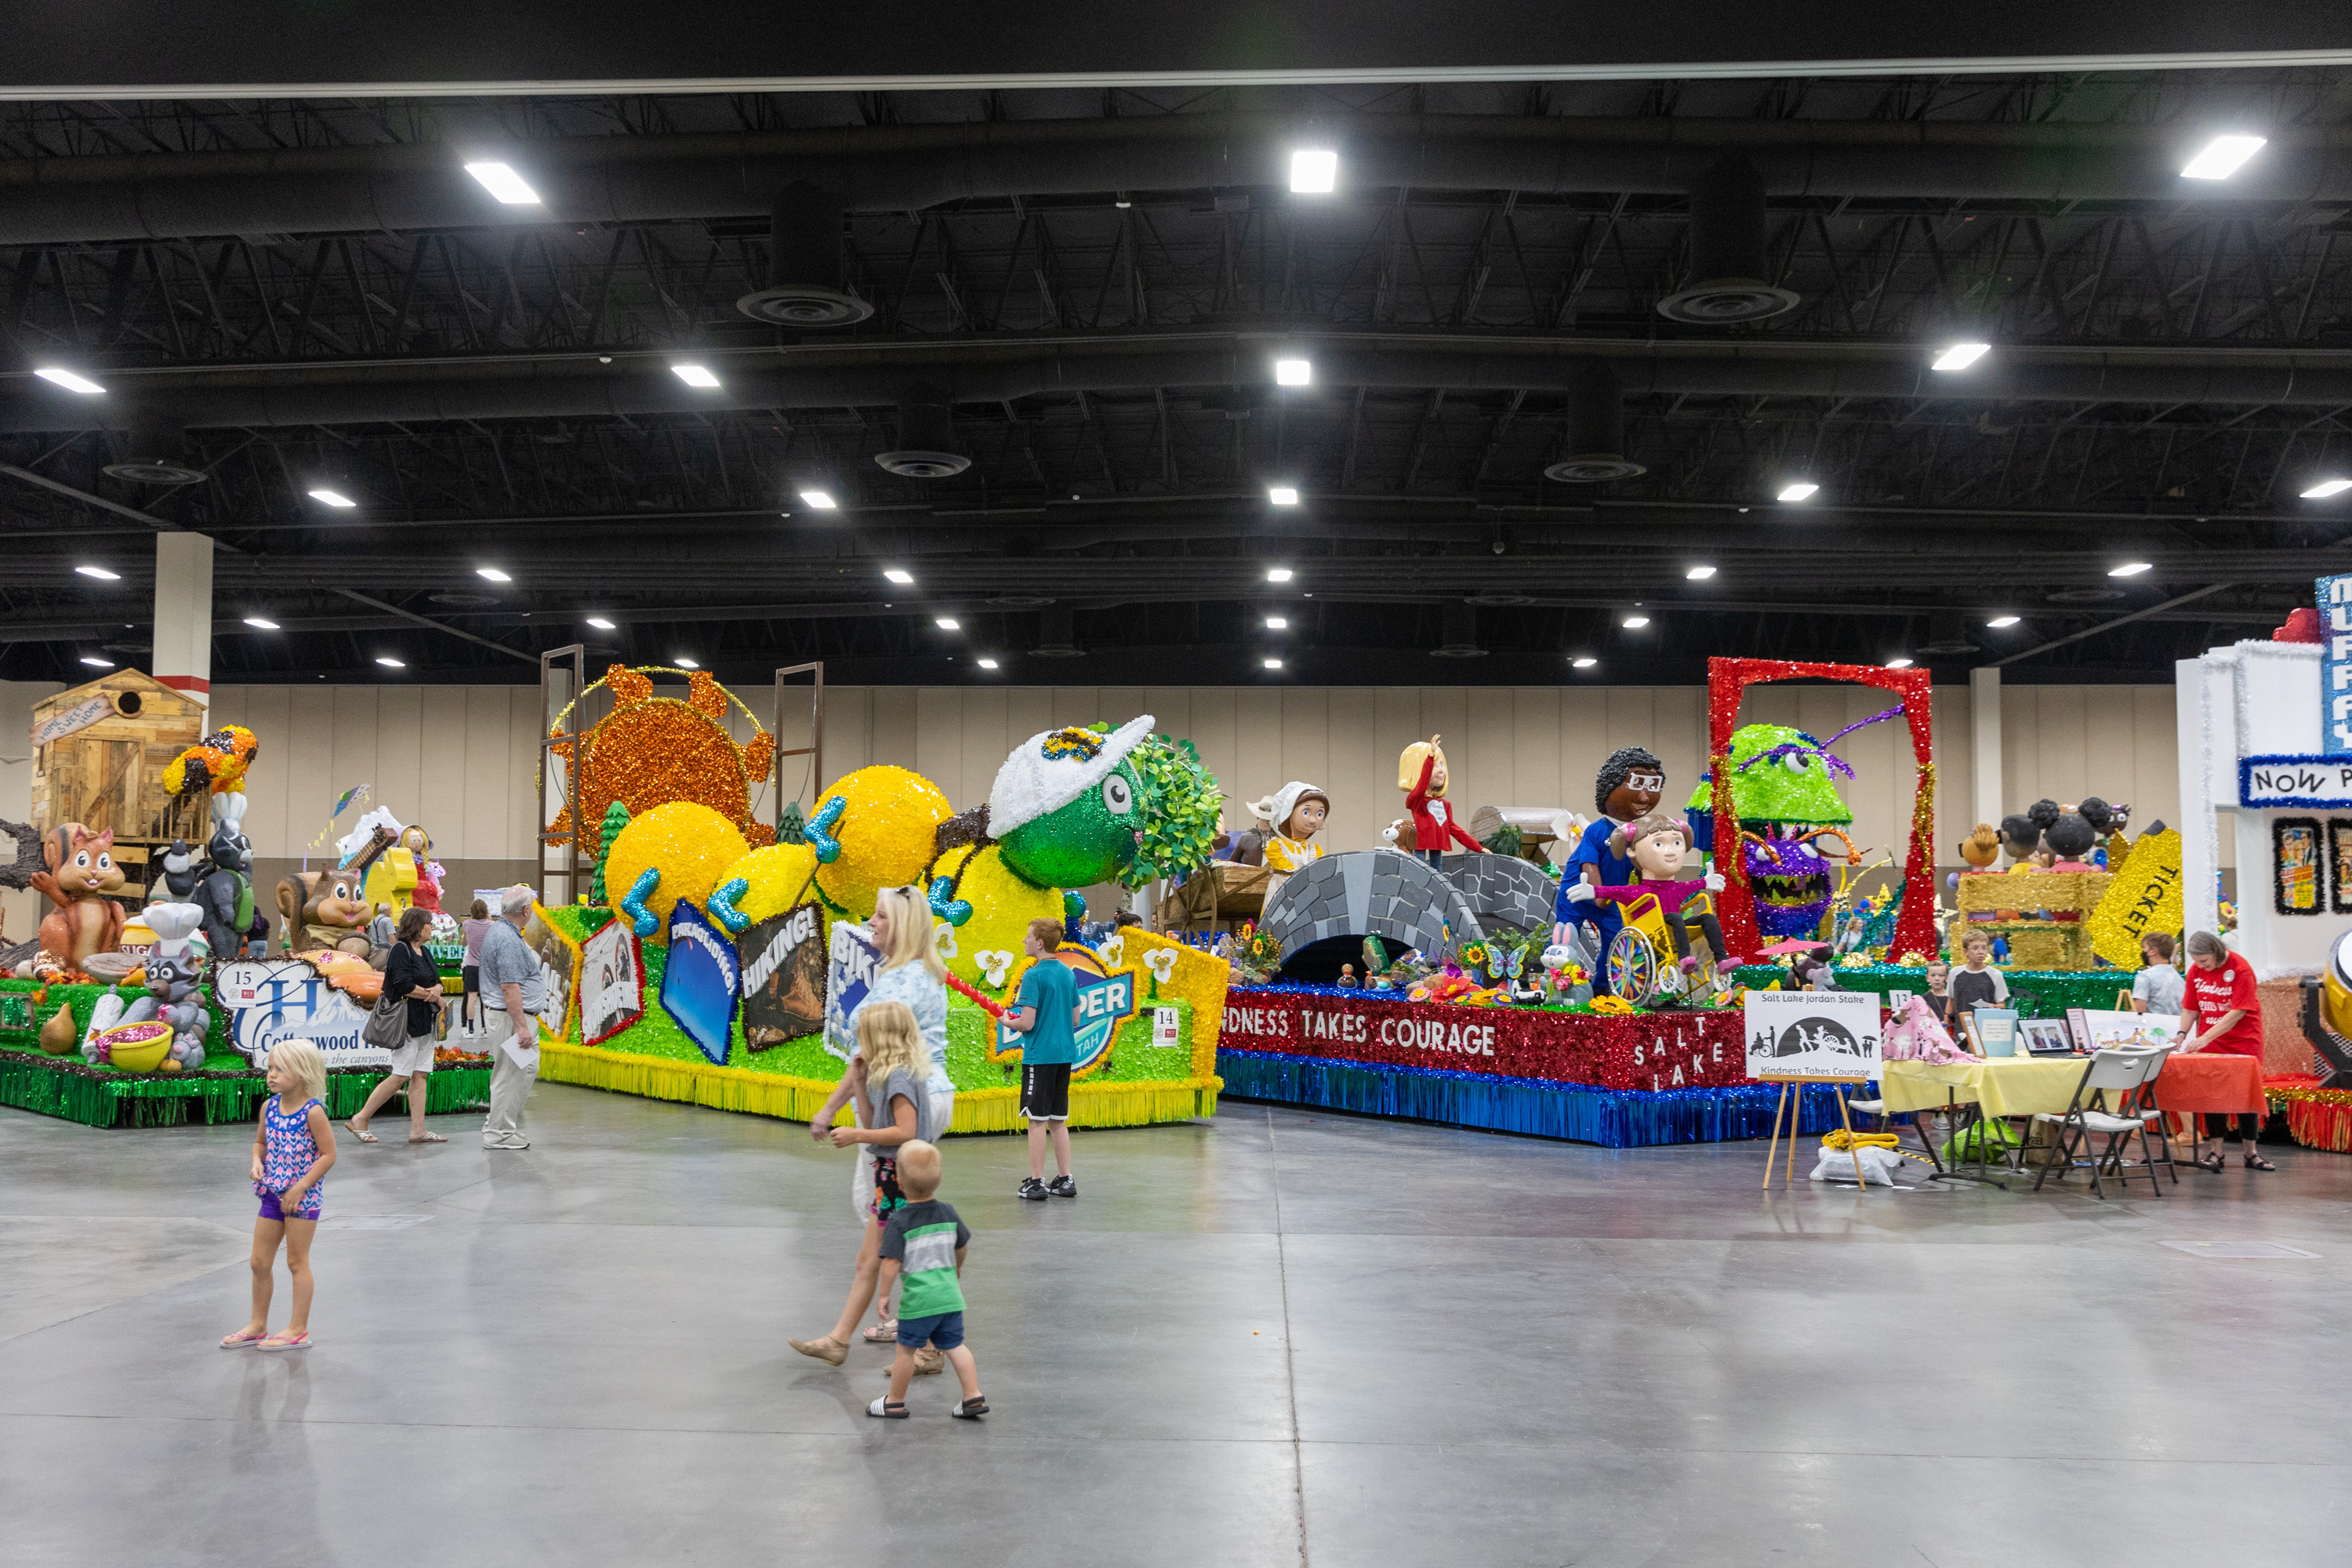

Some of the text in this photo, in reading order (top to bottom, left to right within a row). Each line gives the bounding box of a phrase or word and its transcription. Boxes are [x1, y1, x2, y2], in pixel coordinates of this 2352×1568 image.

[58, 706, 83, 733] SWEET
[79, 701, 102, 724] HOME
[39, 719, 62, 741] HOME
[2255, 768, 2326, 793] NOW
[2123, 866, 2179, 939] TICKET
[742, 906, 817, 999] HIKING!
[235, 971, 252, 985] 15
[1762, 994, 1864, 1004] Salt Lake Jordan Stake
[1160, 1011, 1174, 1024] 14
[261, 1029, 358, 1052] Cottnwood
[1076, 1032, 1099, 1056] TAH
[1301, 1010, 1367, 1044] TAKES
[1381, 1018, 1495, 1056] COURAGE
[332, 1053, 347, 1064] the
[350, 1054, 389, 1065] canyons
[1805, 1067, 1831, 1076] Takes
[1833, 1068, 1871, 1076] Courage
